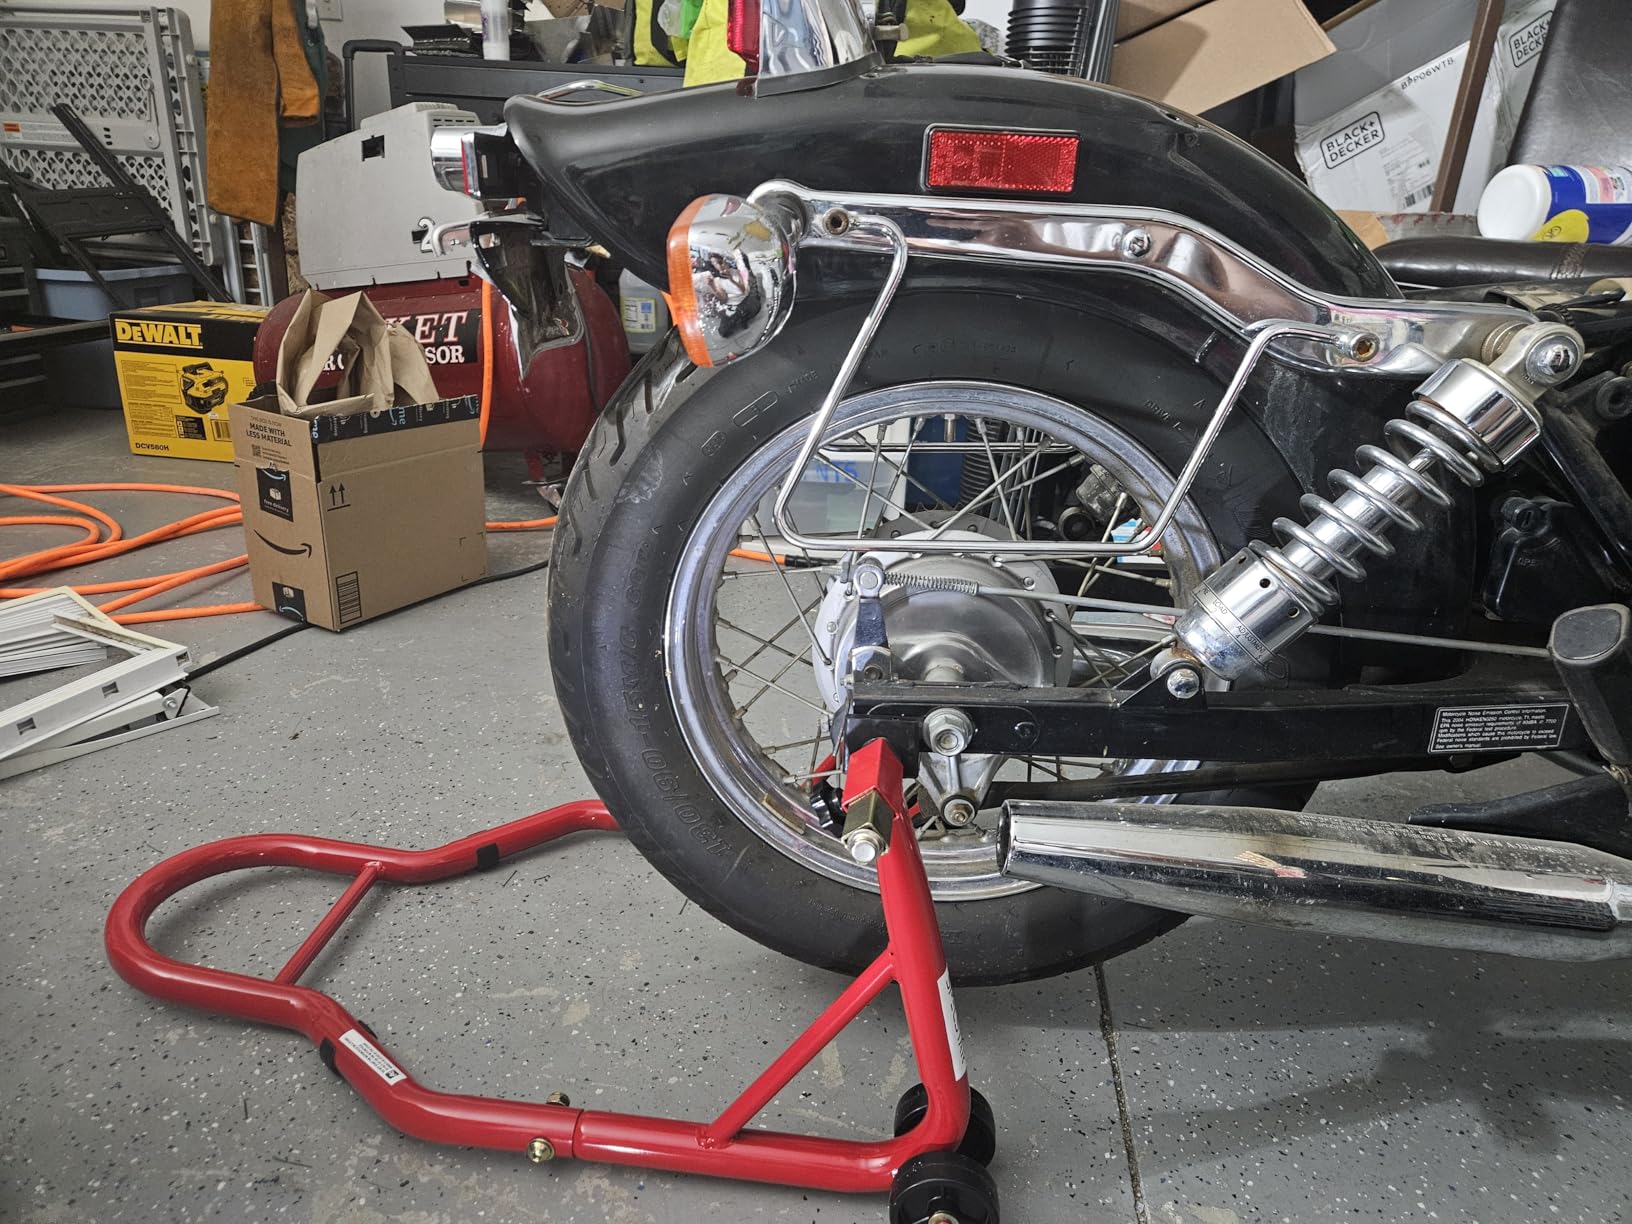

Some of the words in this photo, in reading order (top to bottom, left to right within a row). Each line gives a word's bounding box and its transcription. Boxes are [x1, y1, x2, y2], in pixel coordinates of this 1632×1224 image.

[1330, 129, 1380, 162] DECKER
[246, 430, 260, 438] LESS
[261, 434, 292, 446] MATERIAL
[250, 422, 268, 433] MADE
[268, 427, 285, 438] WITH
